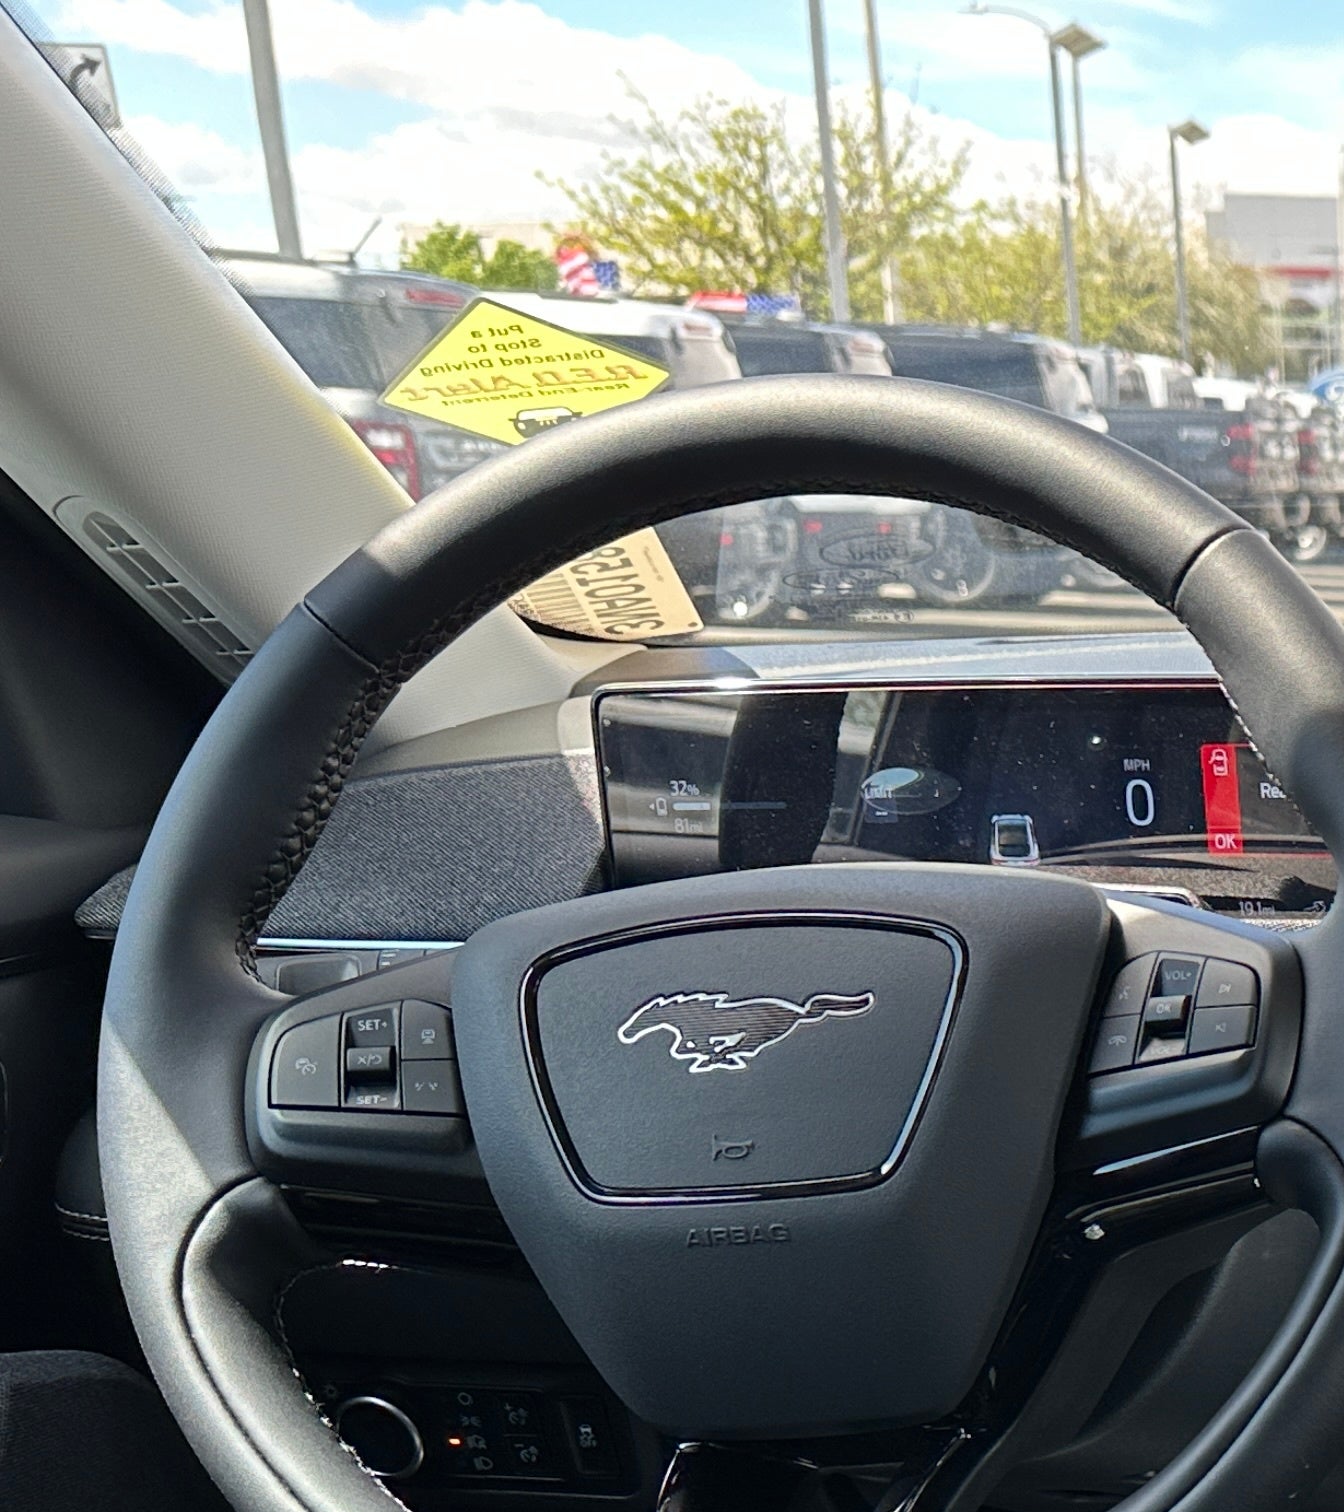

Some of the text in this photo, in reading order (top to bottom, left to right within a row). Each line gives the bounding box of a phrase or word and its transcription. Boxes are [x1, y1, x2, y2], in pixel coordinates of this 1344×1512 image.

[1123, 759, 1151, 772] MPH
[669, 780, 700, 798] 32%
[1260, 782, 1287, 799] Re
[1125, 779, 1155, 827] 0
[1214, 833, 1237, 849] OK
[687, 1223, 792, 1249] AIRBAG
